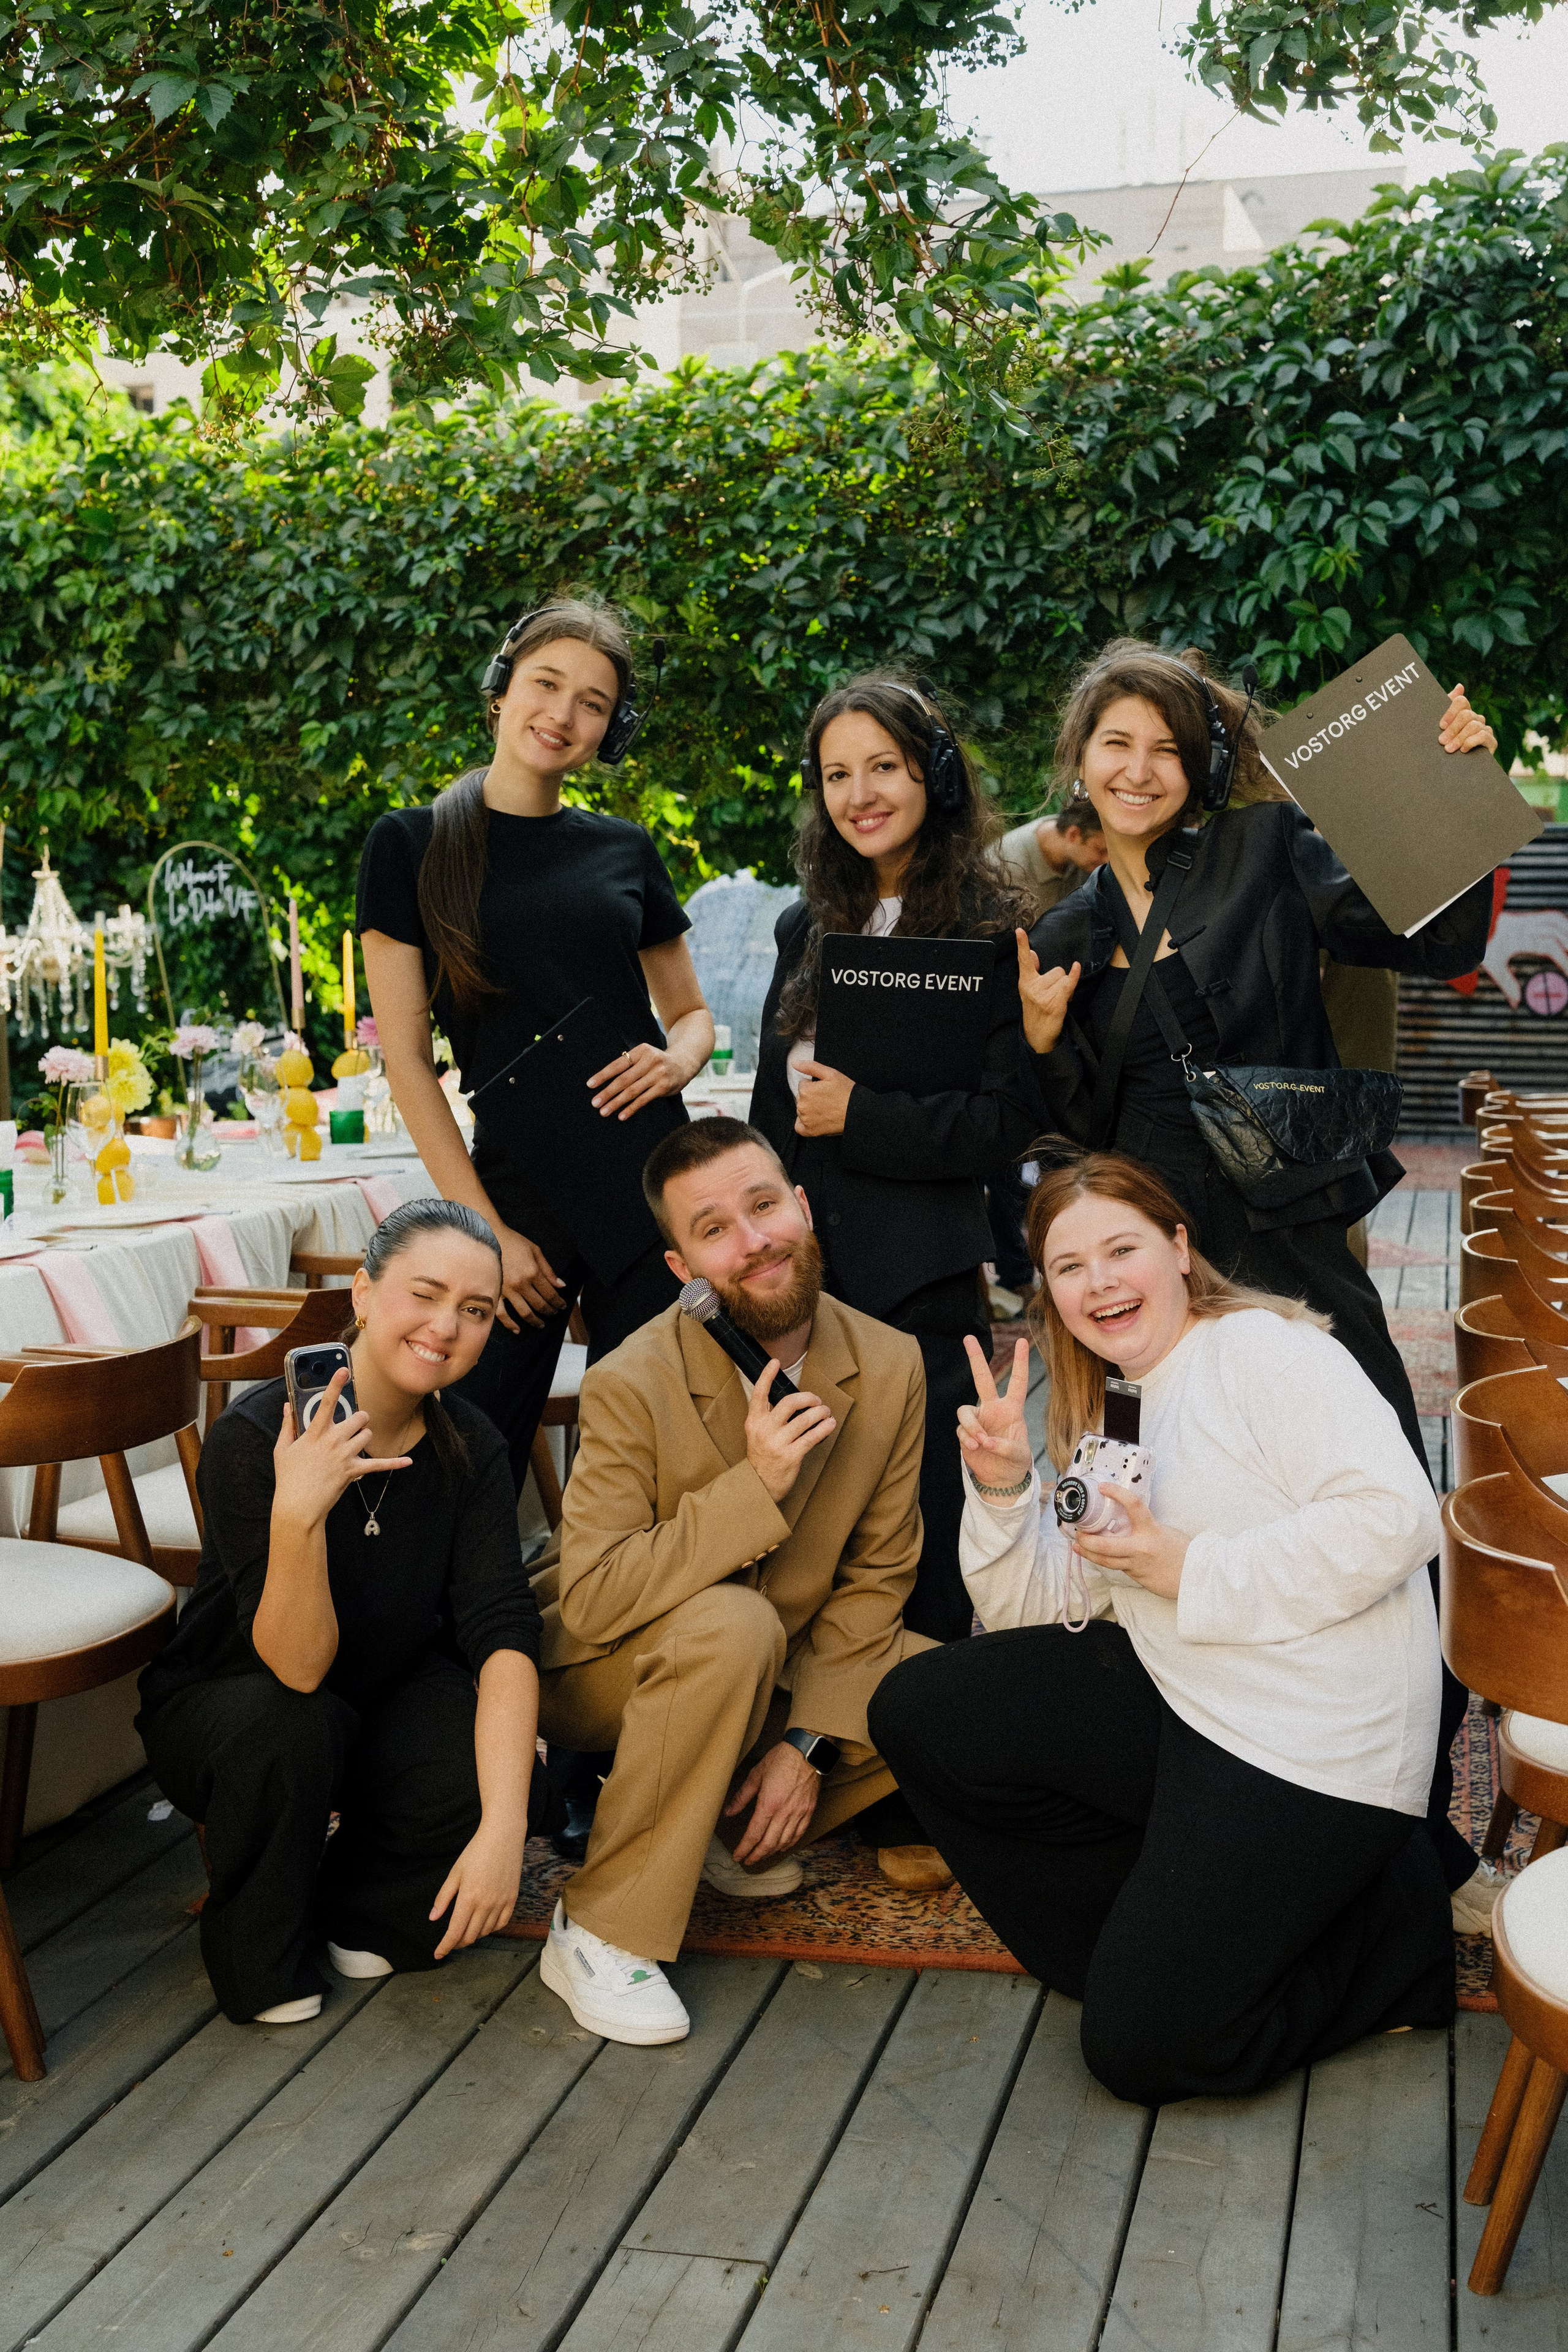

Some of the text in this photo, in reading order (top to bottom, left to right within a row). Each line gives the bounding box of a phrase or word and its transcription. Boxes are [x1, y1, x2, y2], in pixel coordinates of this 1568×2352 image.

[1284, 662, 1420, 769] VOSTORG EVENT
[831, 968, 984, 991] VOSTORG EVENT
[1253, 1082, 1325, 1093] VOSTORG EVENT
